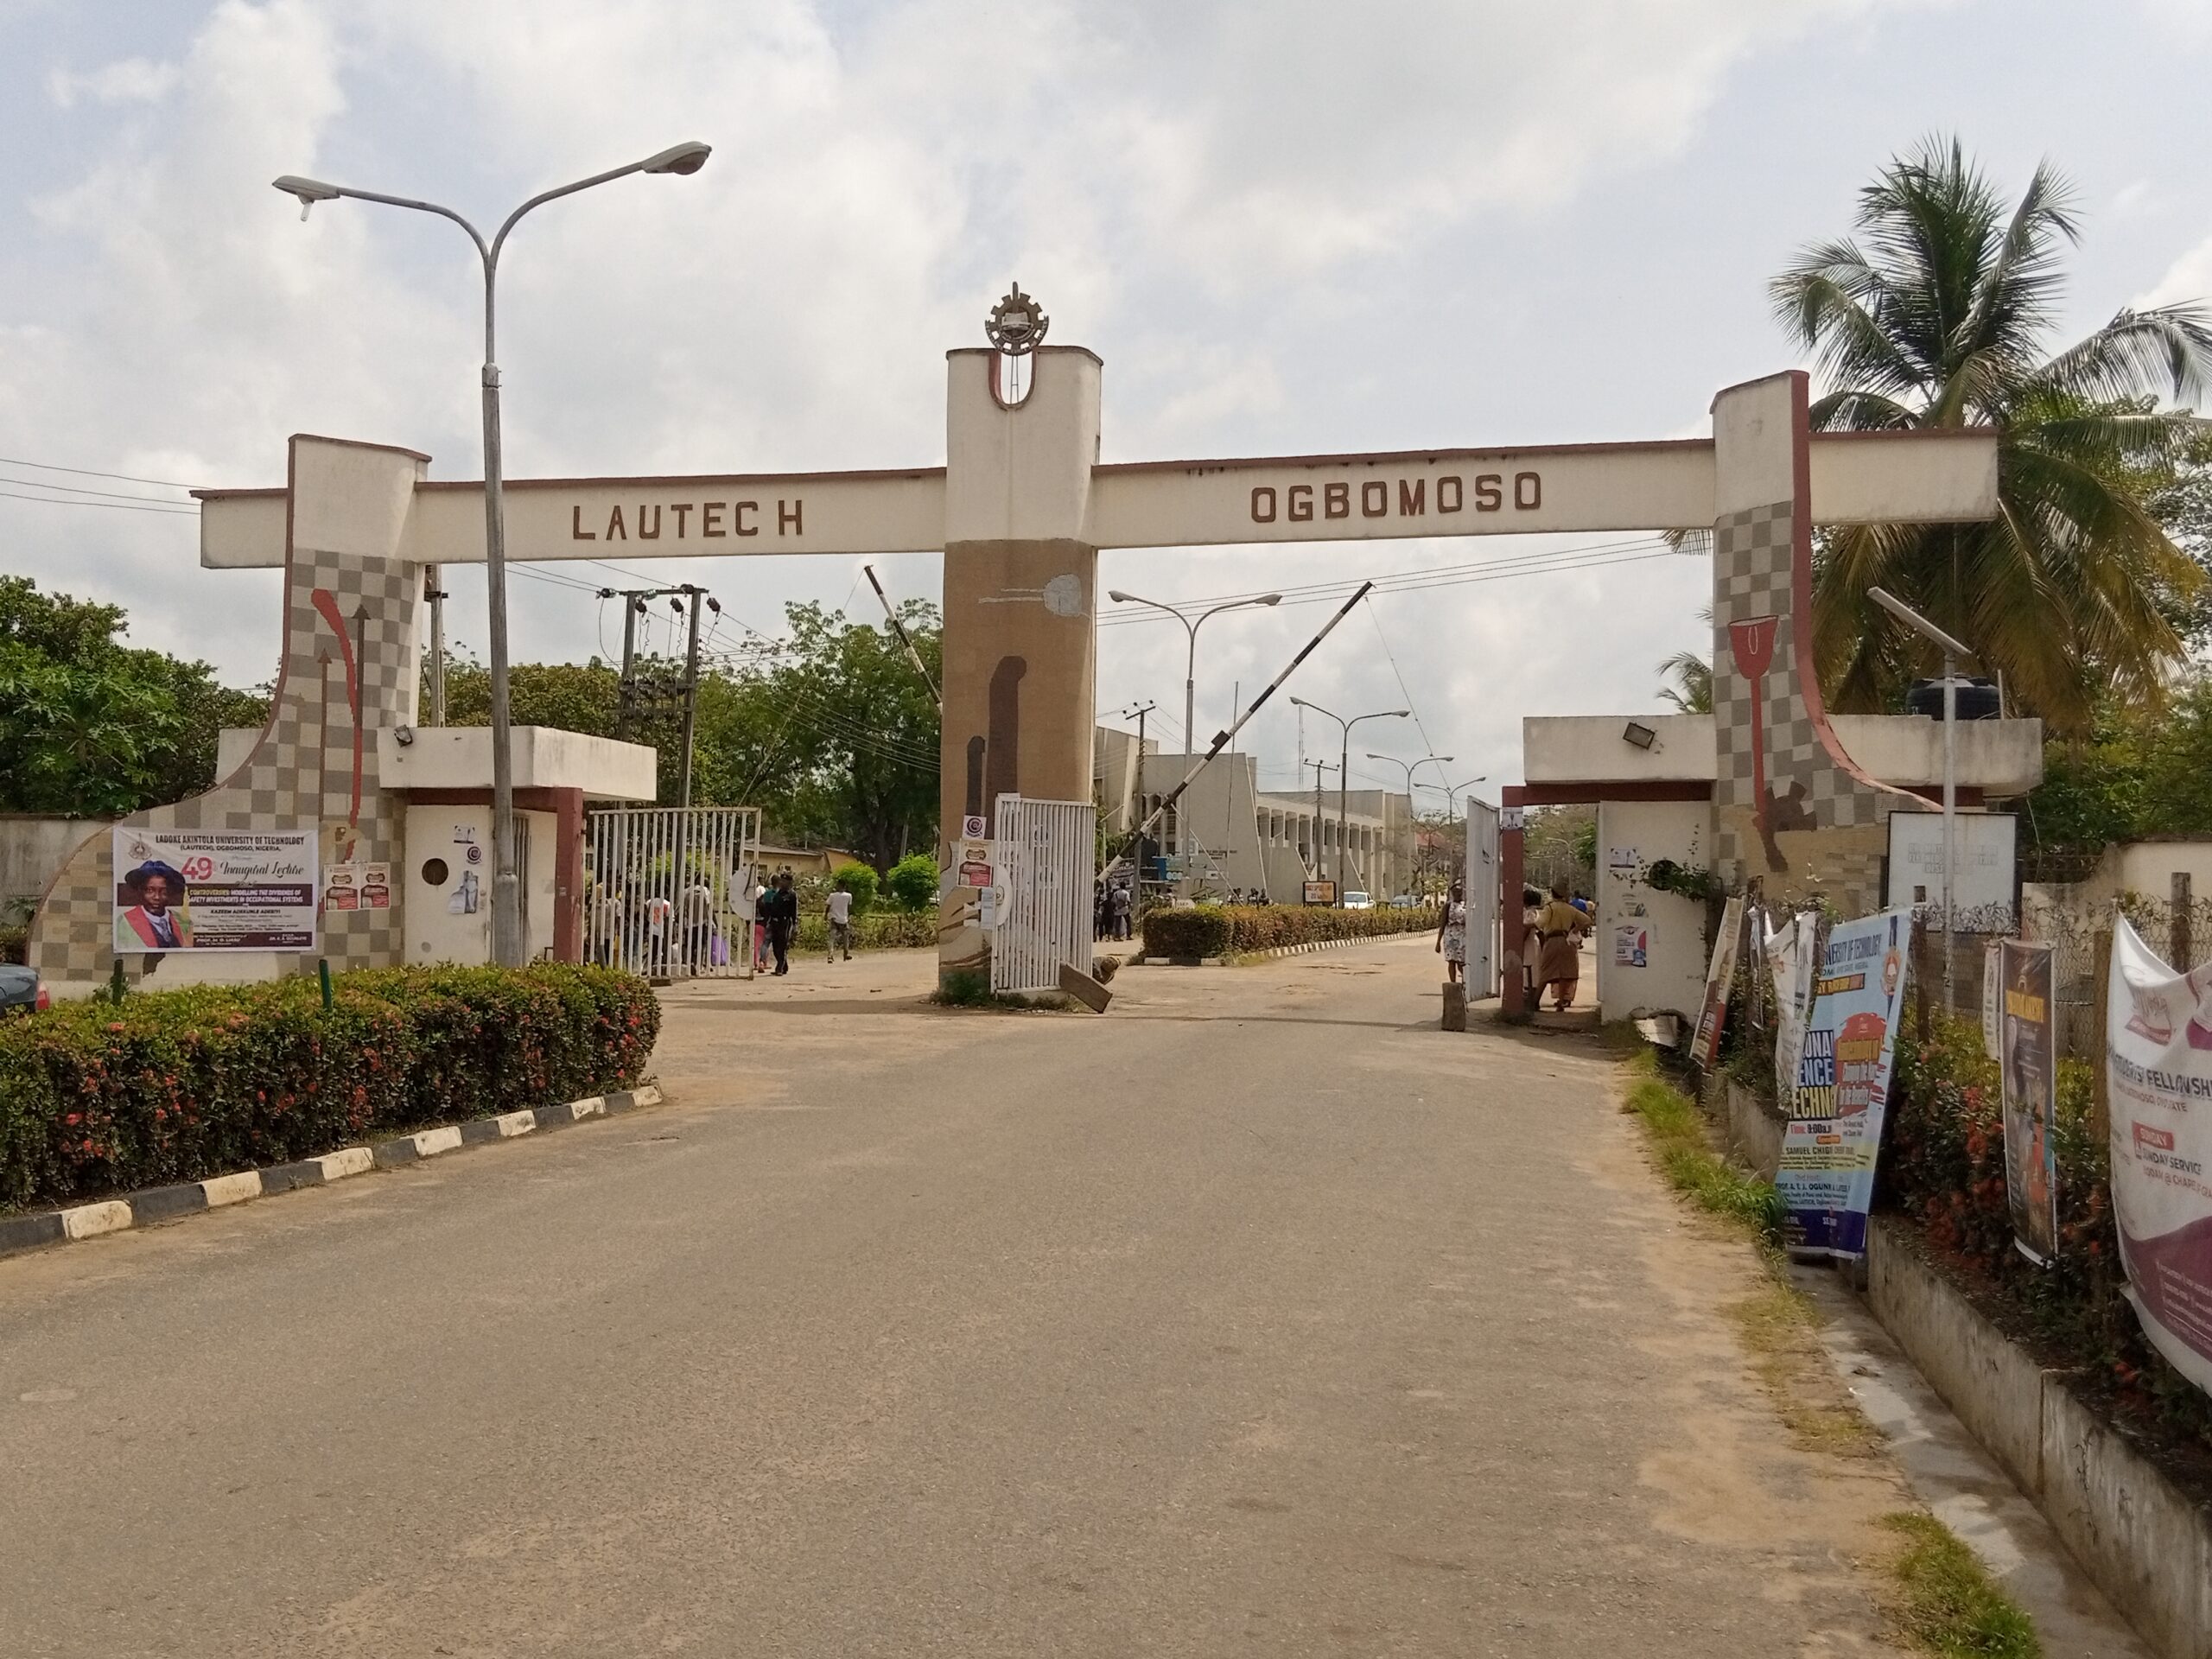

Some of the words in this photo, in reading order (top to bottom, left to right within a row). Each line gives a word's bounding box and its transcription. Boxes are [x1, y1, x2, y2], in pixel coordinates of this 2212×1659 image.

[1251, 472, 1541, 523] OGBOMOSO
[573, 499, 803, 540] LAUTECH
[156, 835, 181, 843] LADOKE
[182, 835, 214, 843] AKINTOLA
[215, 836, 253, 845] UNIVERSITY
[255, 836, 263, 845] OF
[264, 836, 305, 845] TECHNOLOGY
[181, 856, 213, 880] 49
[220, 861, 270, 880] Inaugural
[271, 861, 304, 879] Lecture
[1785, 1147, 1810, 1155] SAMUEL
[2170, 1156, 2202, 1176] SERVICE
